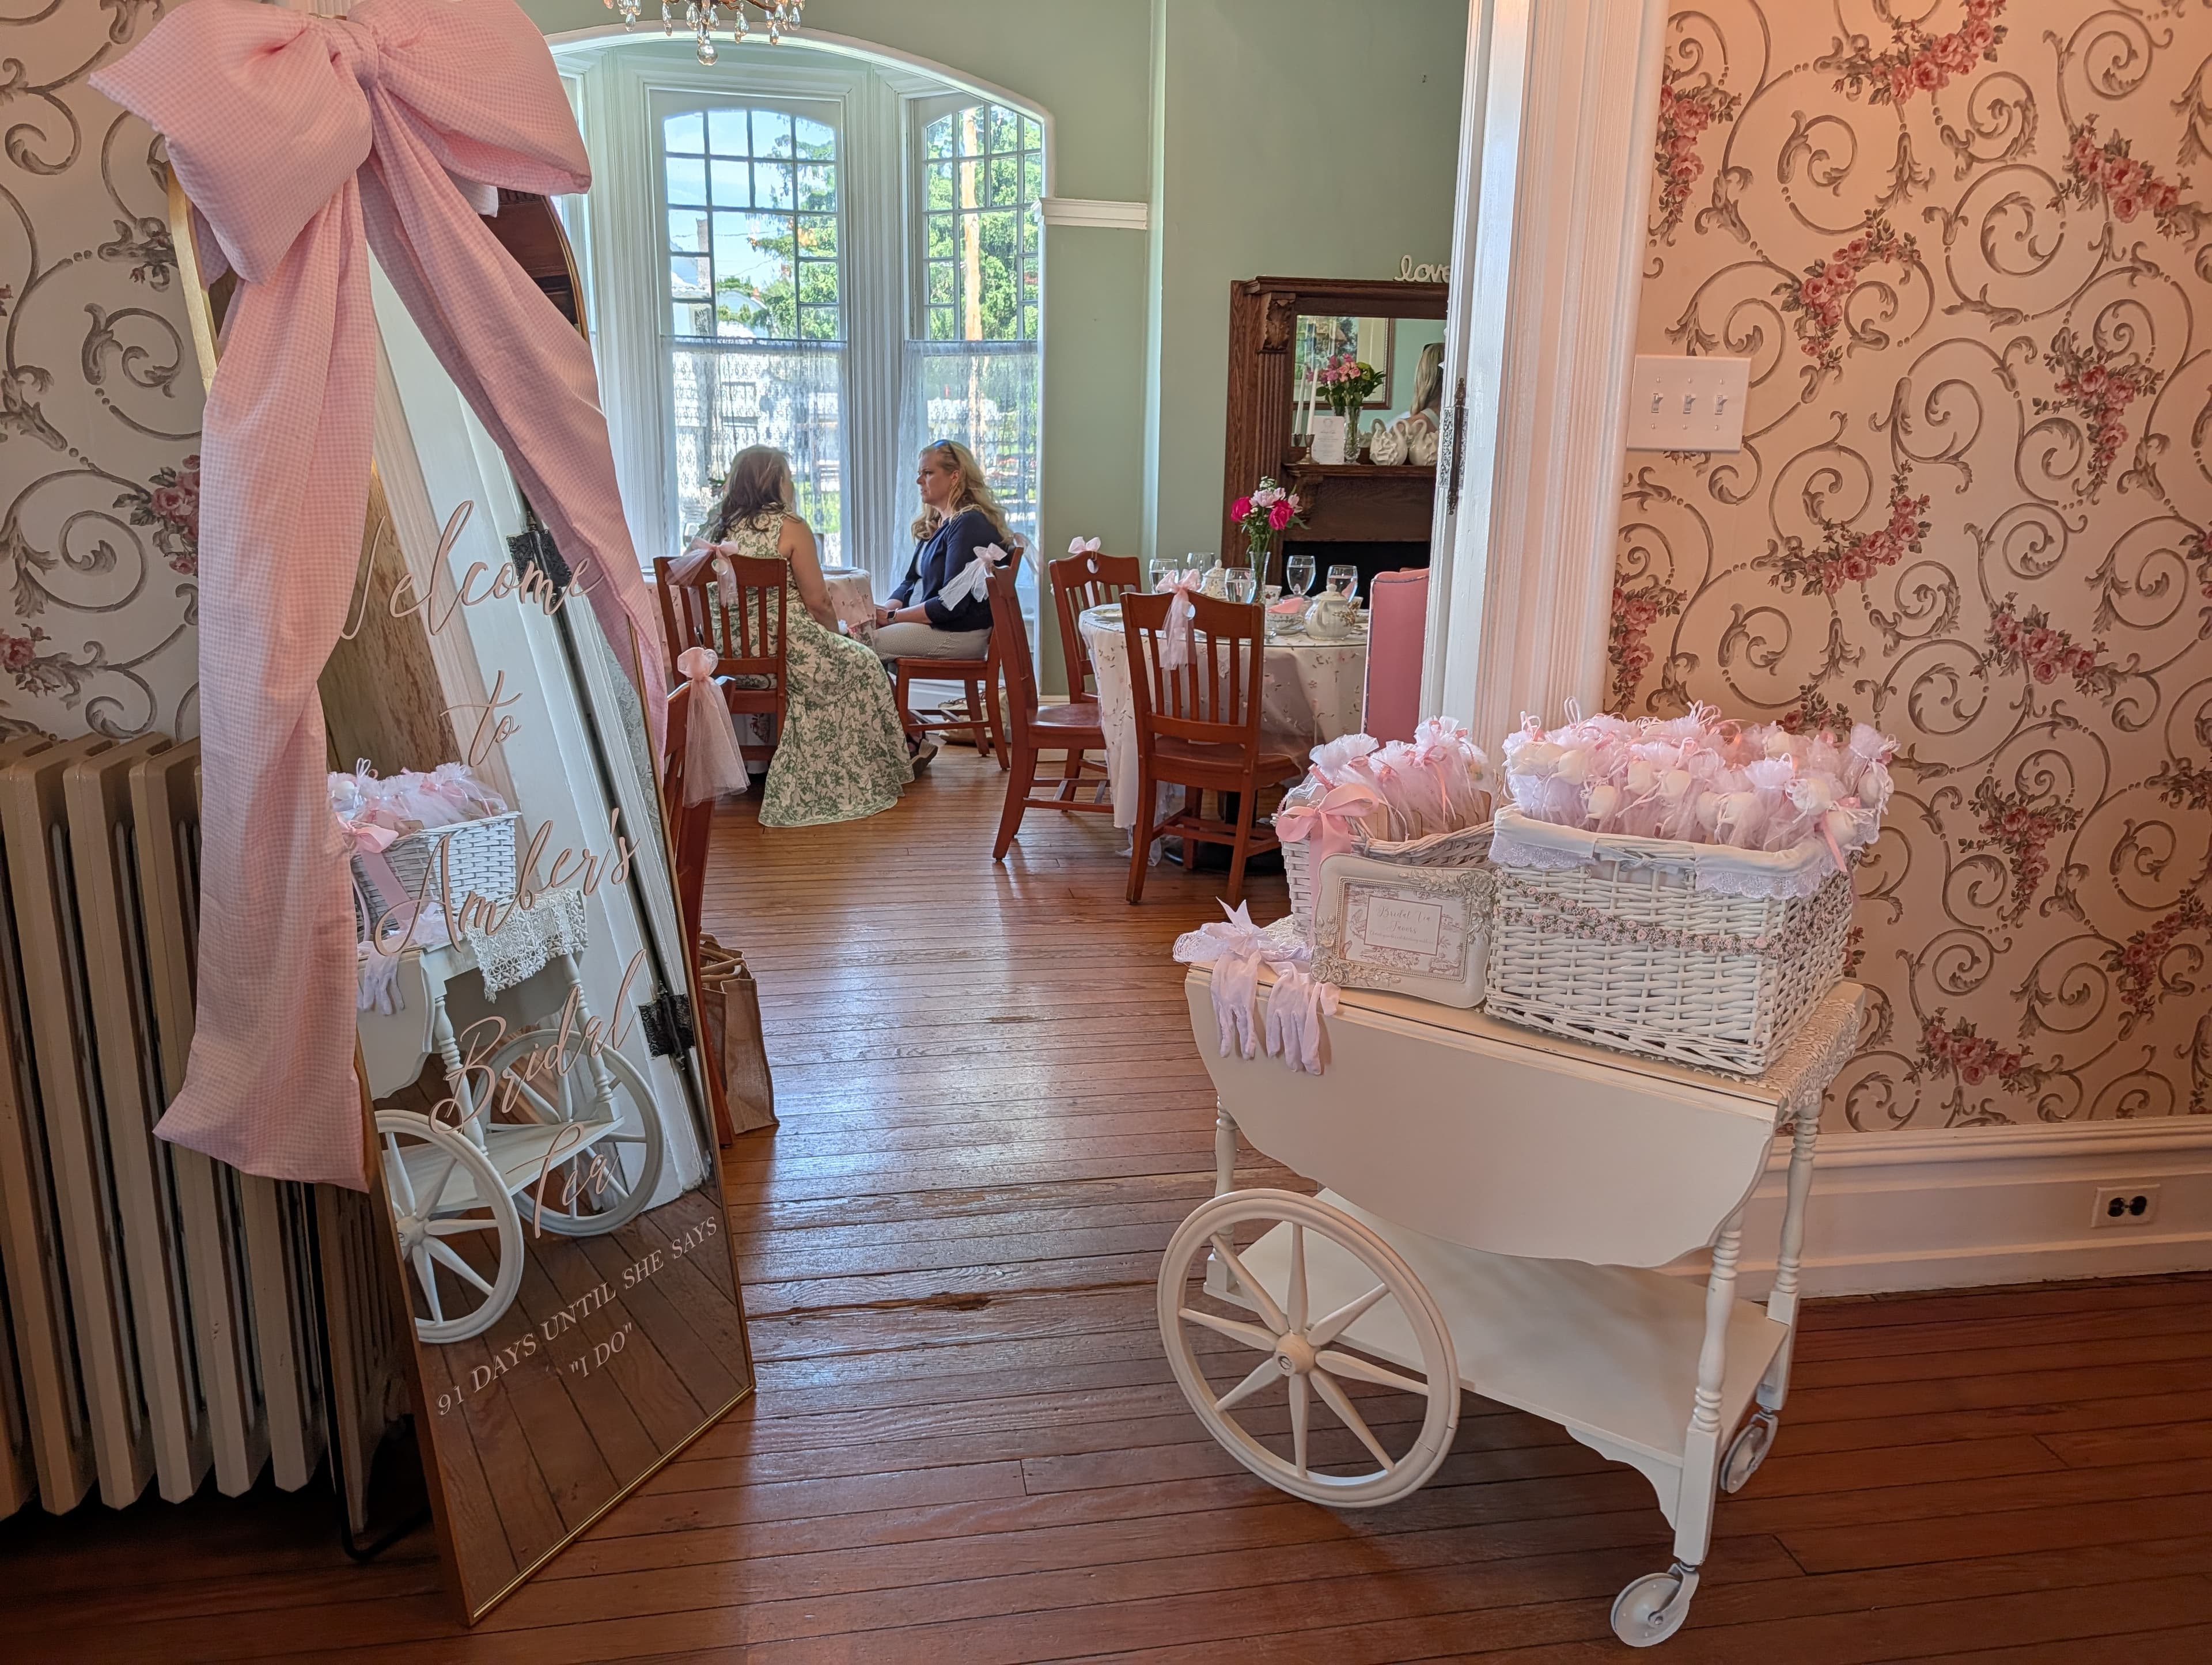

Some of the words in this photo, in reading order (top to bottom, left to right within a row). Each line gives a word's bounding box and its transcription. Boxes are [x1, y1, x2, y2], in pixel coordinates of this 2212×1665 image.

[440, 670, 522, 768] to
[374, 808, 640, 956] Amber's
[1377, 905, 1410, 920] Bridal
[428, 950, 646, 1134] Bridal
[506, 1124, 619, 1238] Tea
[438, 1386, 464, 1416] 91
[471, 1333, 537, 1393] DAYS
[540, 1282, 616, 1342] UNTIL
[622, 1249, 664, 1290] SHE
[671, 1216, 717, 1260] SAYS
[569, 1356, 589, 1377] "I
[593, 1322, 632, 1367] DO"
